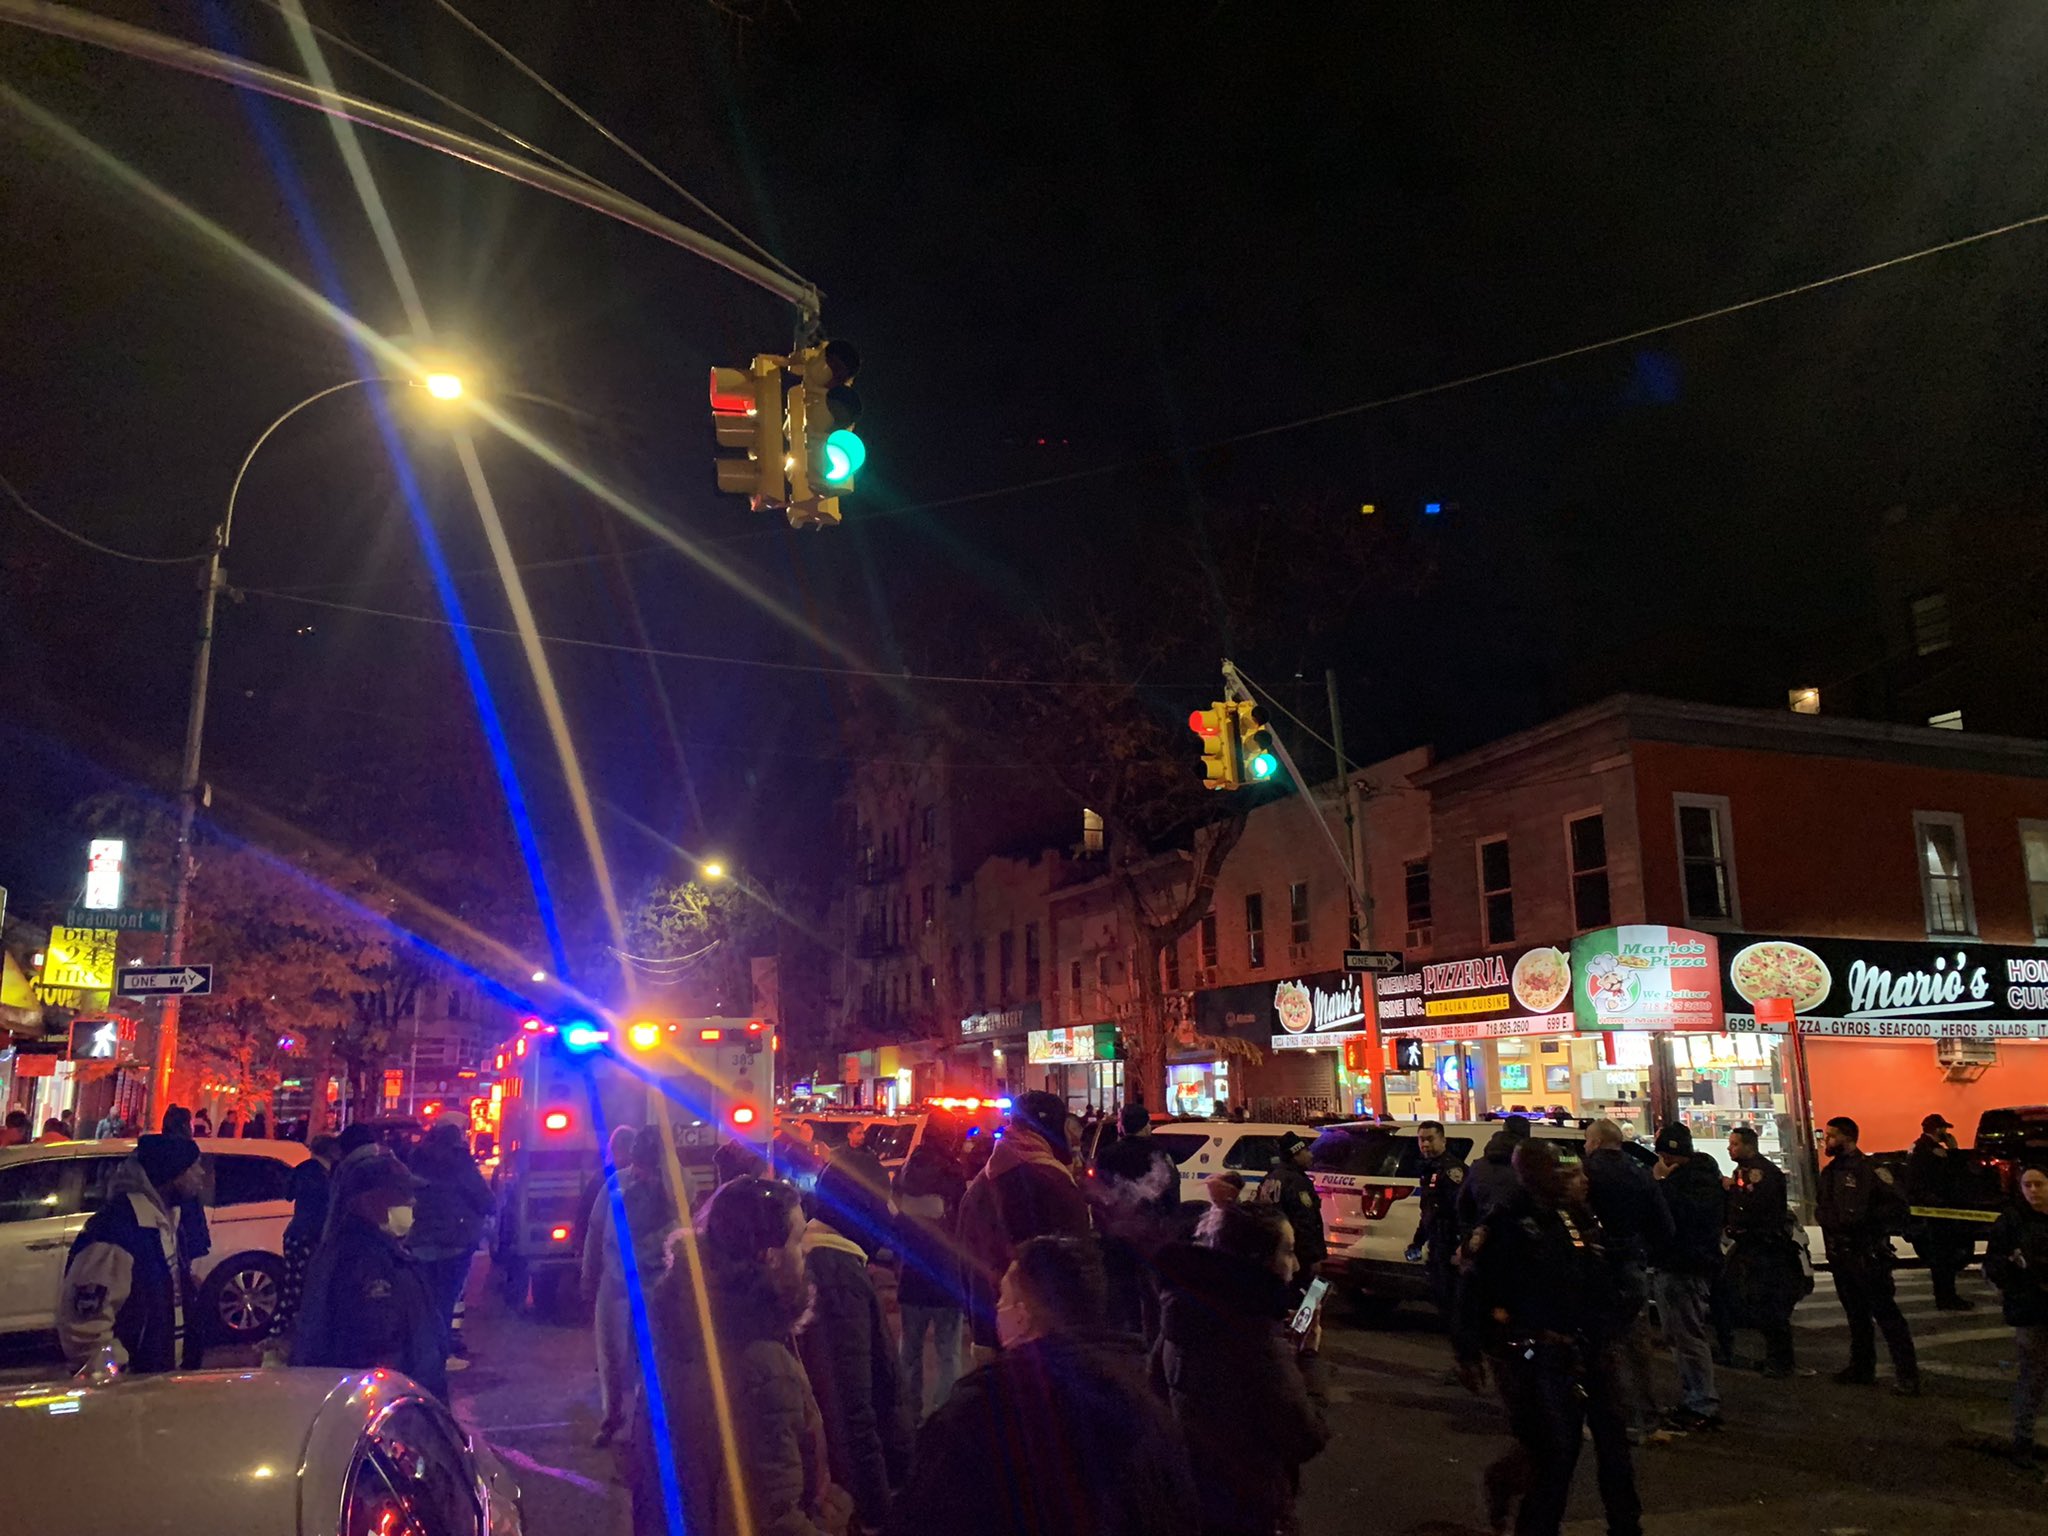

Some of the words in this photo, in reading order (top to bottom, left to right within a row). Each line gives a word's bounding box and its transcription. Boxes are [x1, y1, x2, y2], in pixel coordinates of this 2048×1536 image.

[67, 910, 143, 928] Beaumont
[1623, 940, 1705, 954] Mario's
[63, 945, 98, 967] 24
[1352, 957, 1368, 966] ONE
[1377, 957, 1394, 966] WAY
[1650, 956, 1707, 967] Pizza
[55, 969, 104, 984] HRS
[131, 976, 156, 987] ONE
[170, 975, 196, 986] WAY
[1423, 955, 1509, 994] PIZZERIA
[1849, 952, 1989, 1011] Mario's
[1377, 973, 1422, 995] OMEMADE
[1314, 974, 1361, 1027] Mario's
[1642, 990, 1660, 998] We
[1665, 990, 1710, 999] Deliver
[1436, 1000, 1469, 1013] ITALIAN
[1473, 996, 1508, 1009] CUISINE
[1547, 1016, 1561, 1031] 699
[1729, 1018, 1755, 1031] 699
[1793, 1021, 1821, 1033] IZZA
[1832, 1021, 1870, 1034] GYROS
[1879, 1022, 1930, 1035] SEAFOOD
[1941, 1024, 1977, 1036] HEROS
[1988, 1025, 2028, 1036] SALADS
[732, 1054, 754, 1066] 383
[1322, 1175, 1356, 1186] POLICE
